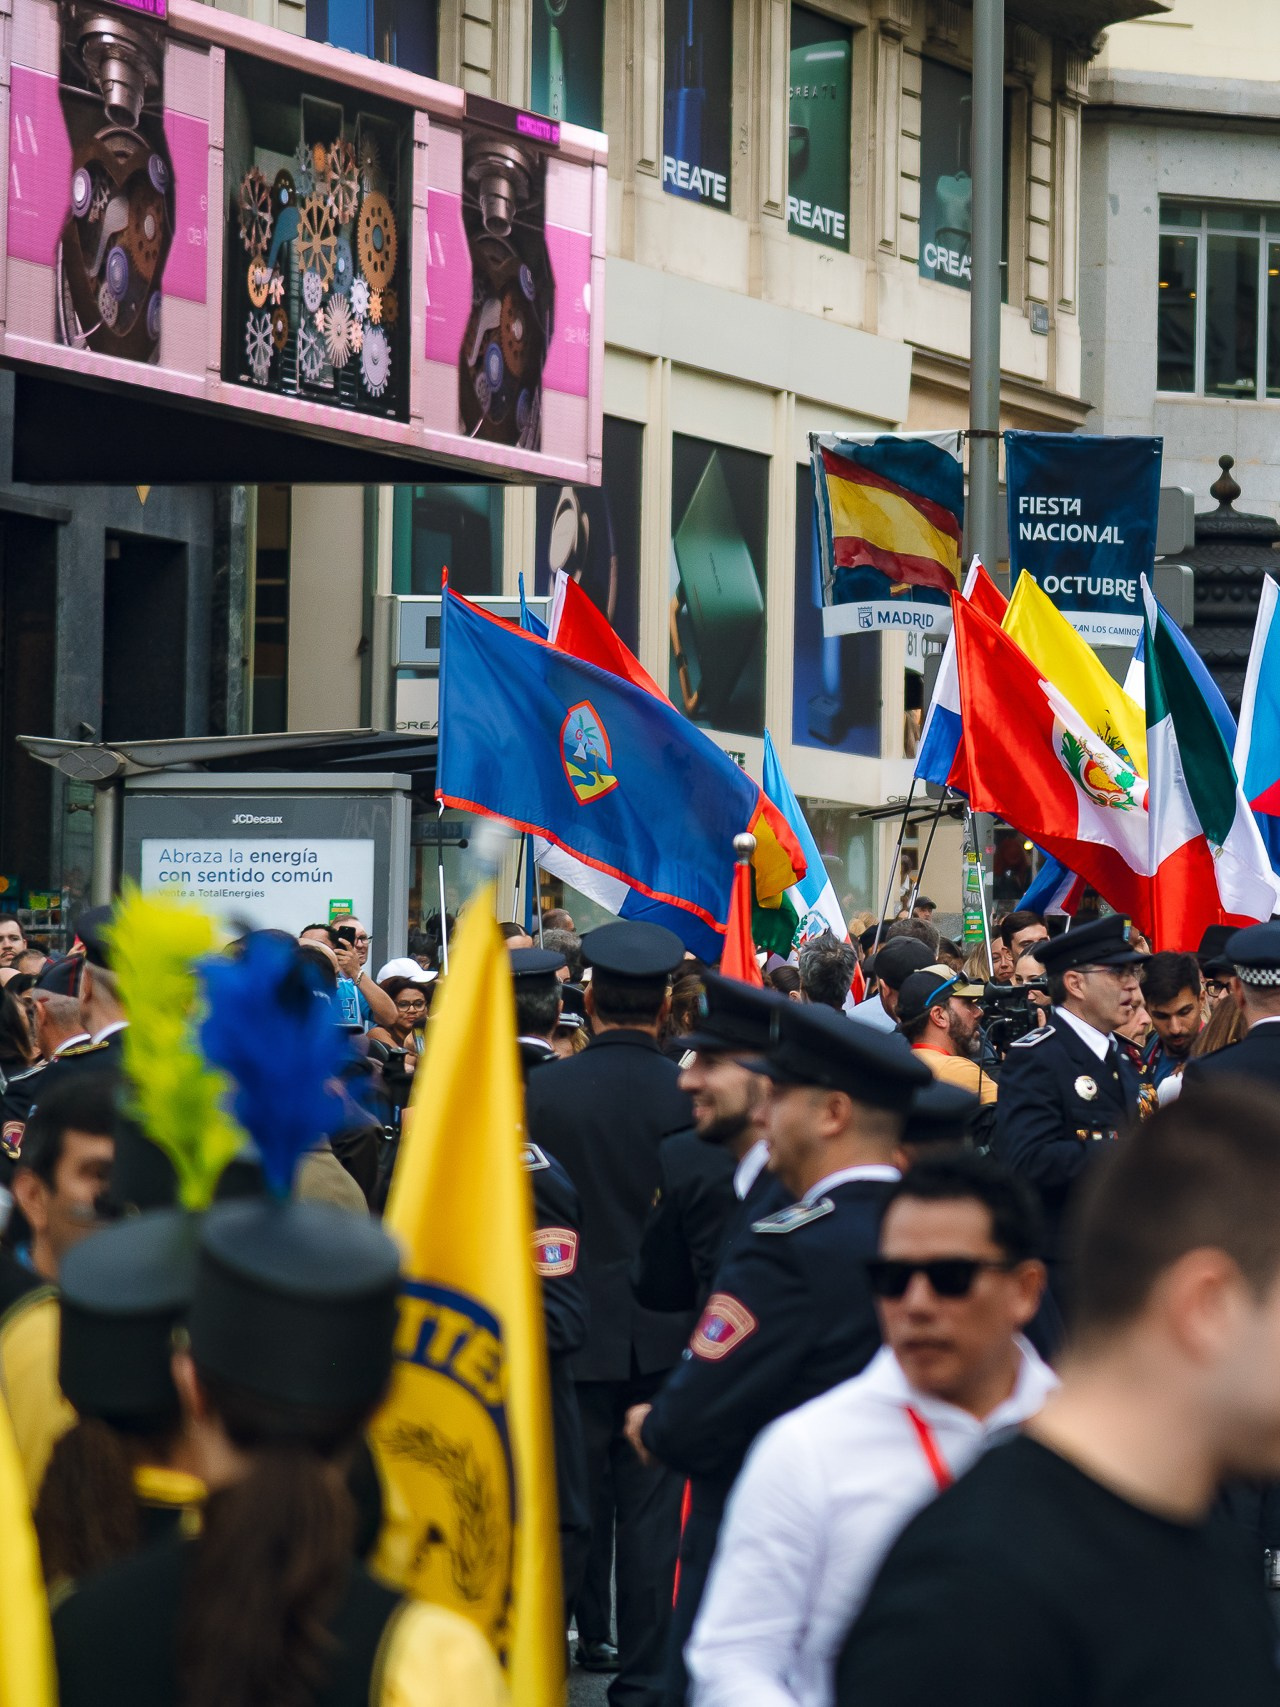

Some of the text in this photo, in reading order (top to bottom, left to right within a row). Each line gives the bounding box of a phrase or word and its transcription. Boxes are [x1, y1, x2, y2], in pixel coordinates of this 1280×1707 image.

[924, 243, 972, 280] CREA
[1019, 496, 1082, 516] FIESTA
[1019, 523, 1124, 545] NACIONAL
[1043, 575, 1137, 602] OCTUBRE
[877, 611, 934, 629] MADRID
[1092, 625, 1107, 634] LOS
[1108, 626, 1140, 637] CAMINOS
[232, 814, 283, 825] JCDecaux
[158, 848, 318, 866] Abraza la energía
[158, 867, 333, 883] con sentido común
[198, 889, 265, 899] TotalEnergies
